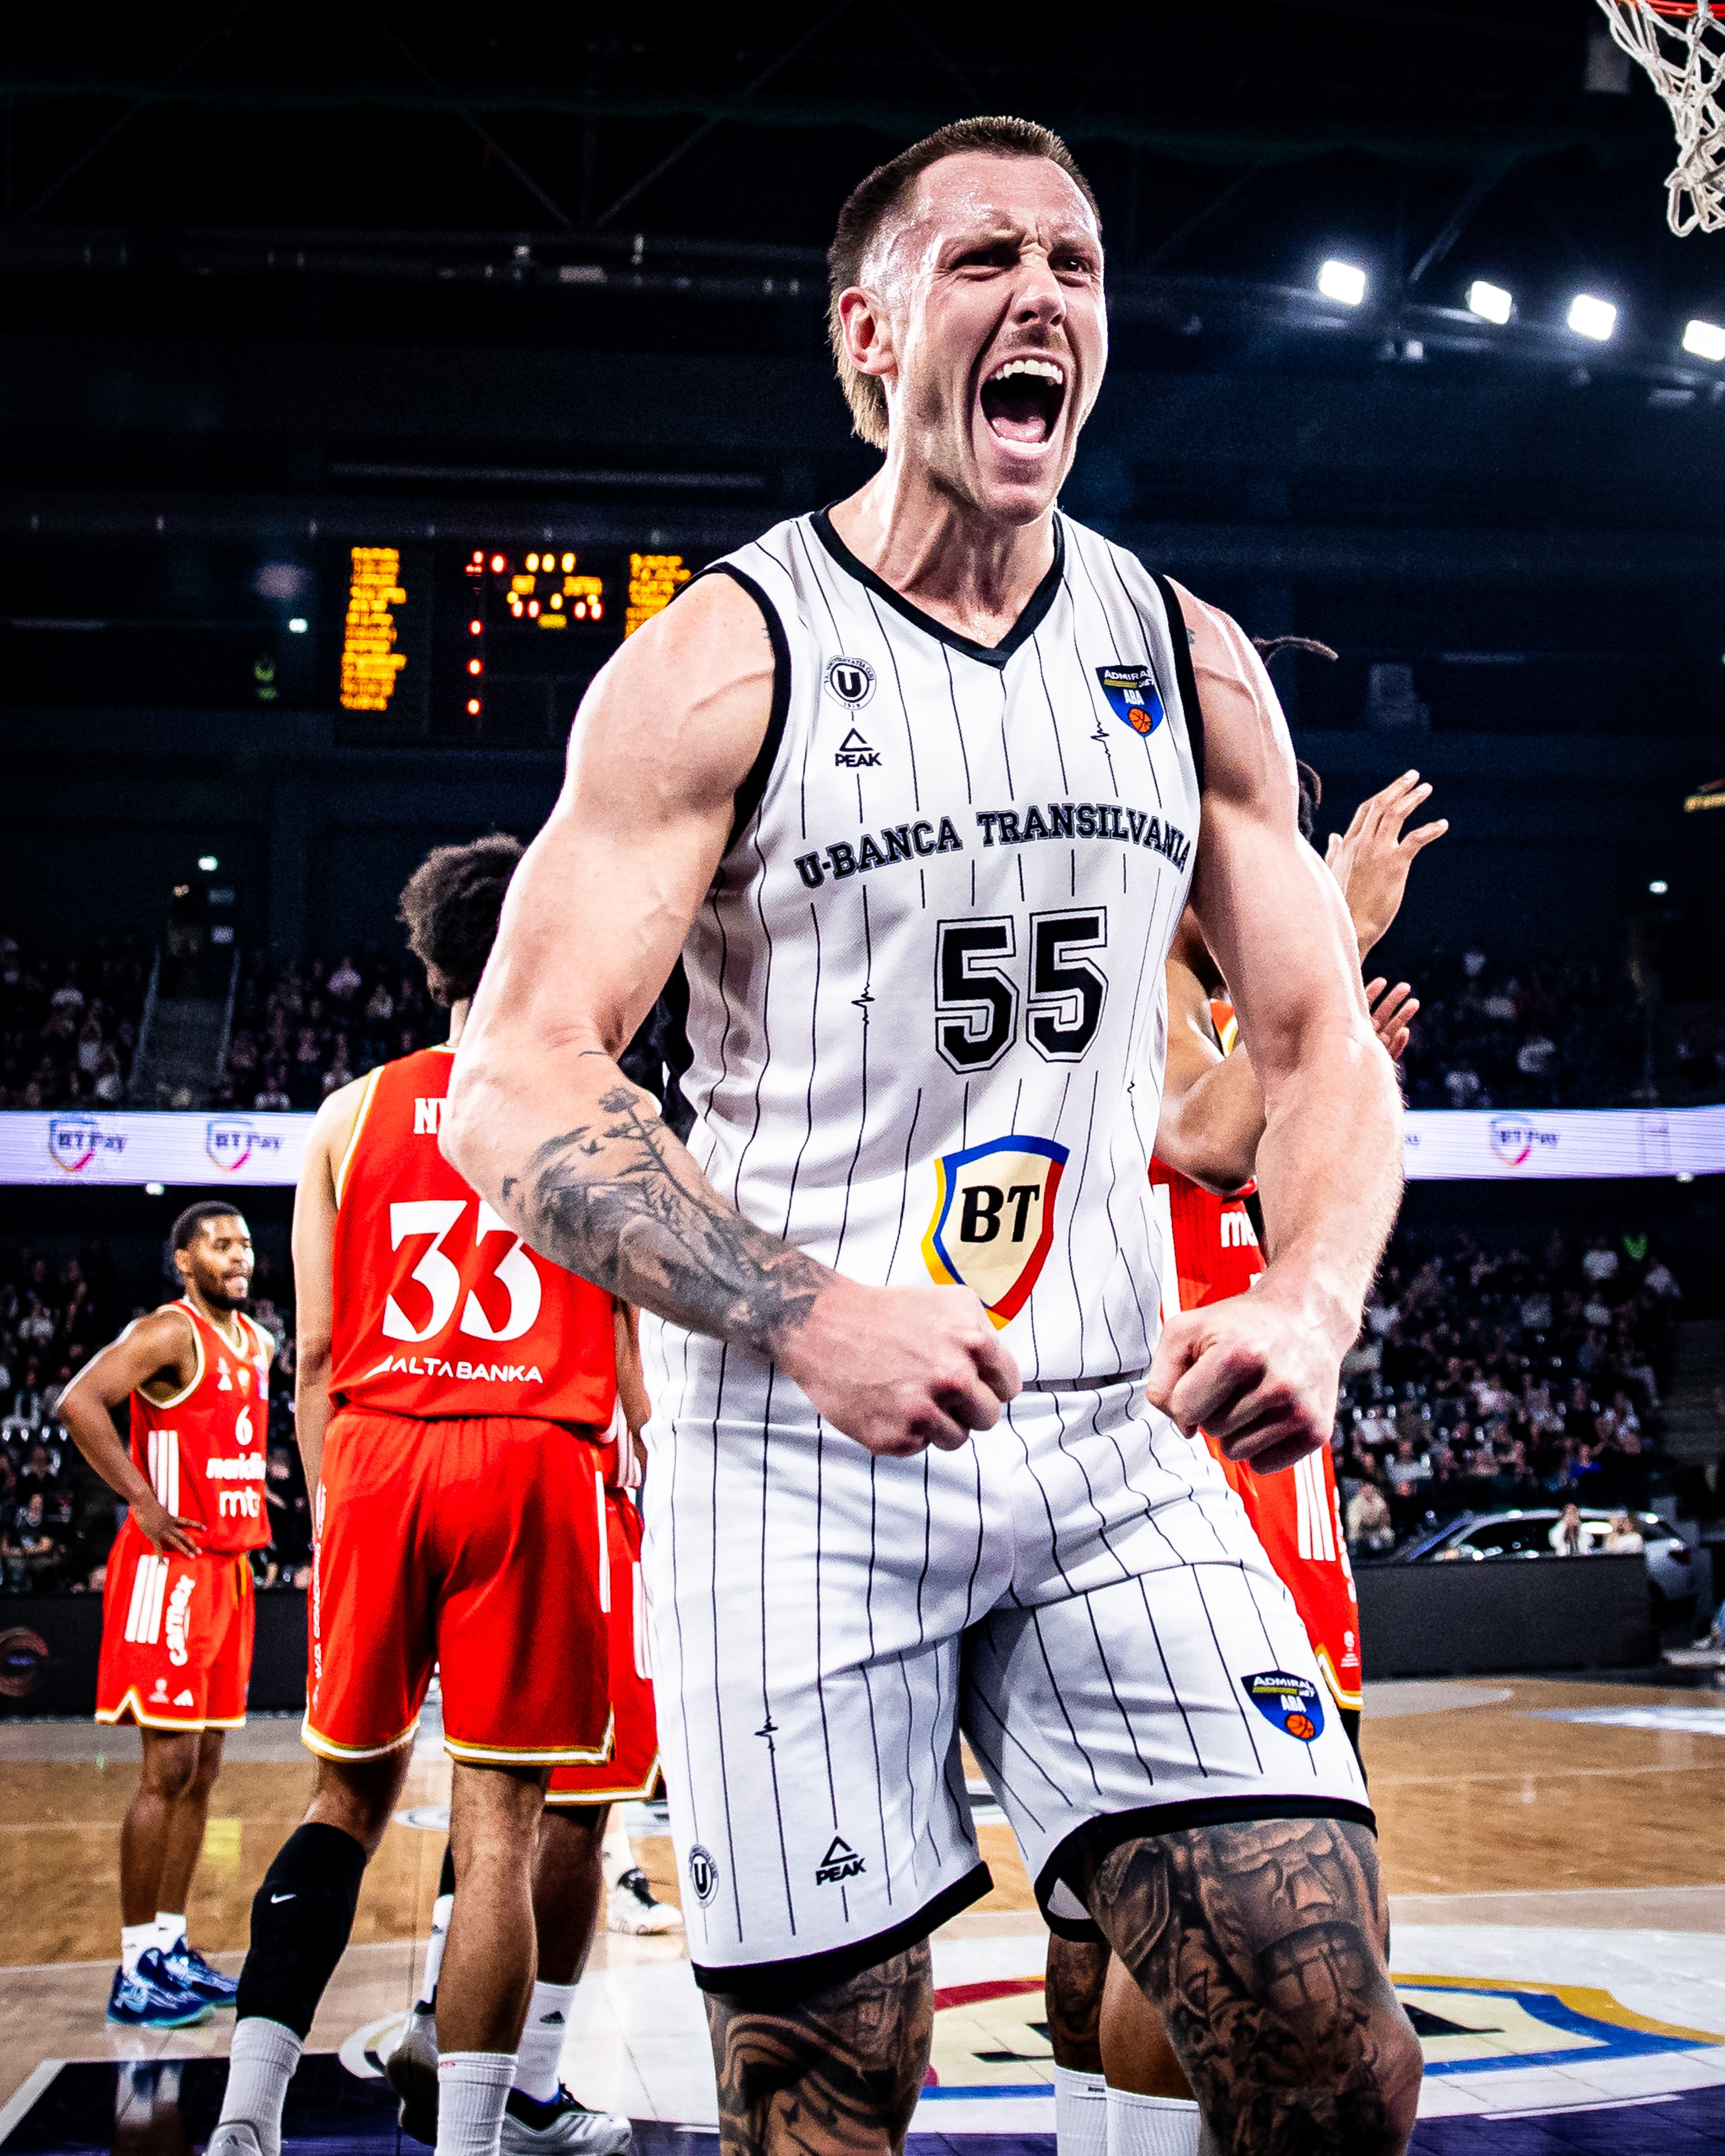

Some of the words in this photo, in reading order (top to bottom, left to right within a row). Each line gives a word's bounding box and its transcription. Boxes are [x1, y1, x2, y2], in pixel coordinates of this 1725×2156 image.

[836, 669, 862, 698] U
[835, 752, 882, 767] PEAK
[793, 816, 964, 889] U-BANCA
[976, 803, 1191, 875] TRANSILVANIA
[934, 906, 1109, 1075] 55
[960, 1182, 1039, 1243] BT
[382, 1200, 542, 1343] 33
[235, 1405, 253, 1445] 6
[694, 1863, 708, 1894] U
[815, 1857, 867, 1886] PEAK
